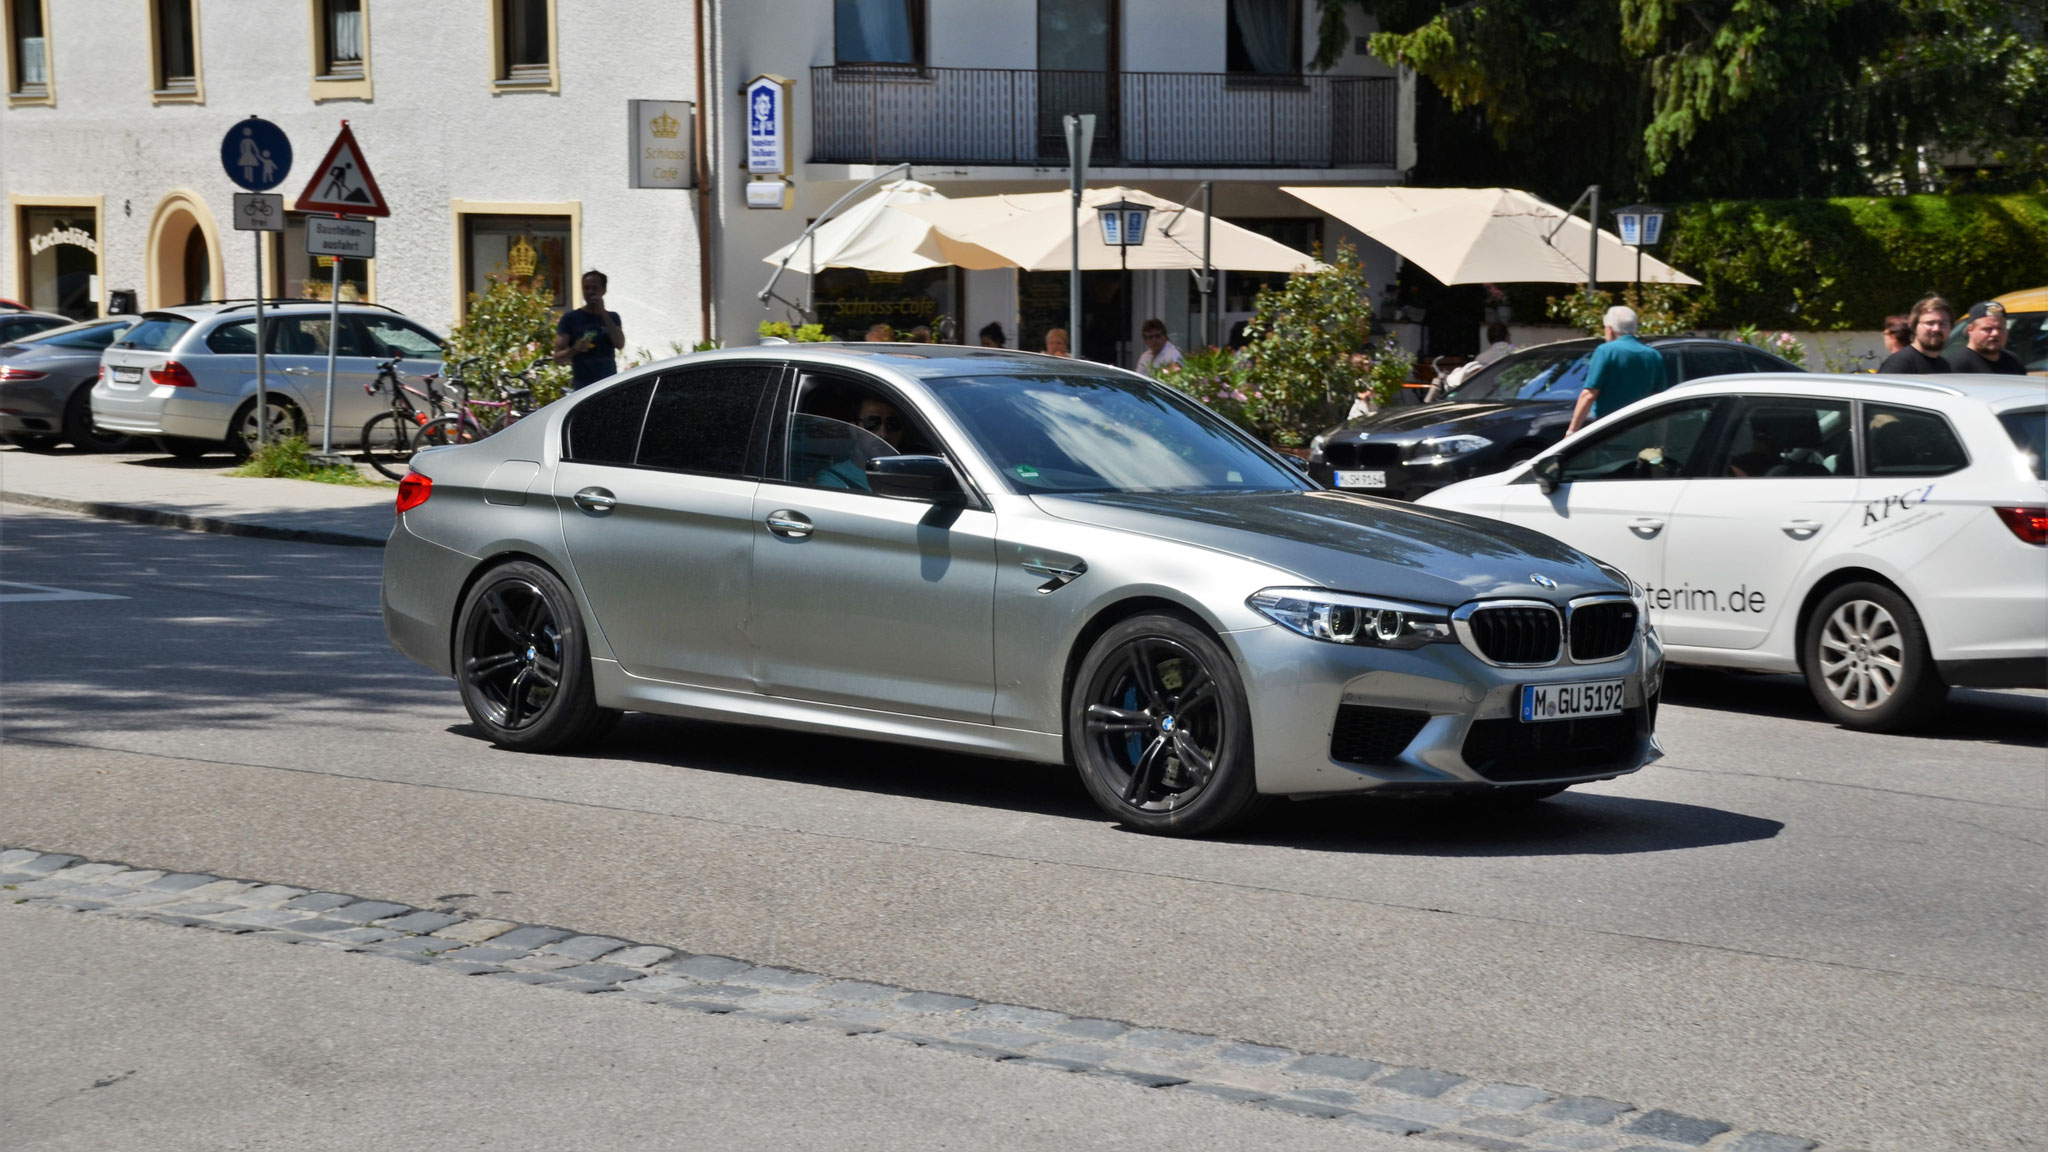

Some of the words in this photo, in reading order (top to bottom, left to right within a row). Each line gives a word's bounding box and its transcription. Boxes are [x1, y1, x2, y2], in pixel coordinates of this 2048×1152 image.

[645, 147, 686, 160] Schloss
[316, 223, 366, 237] Baustellen-
[322, 240, 359, 251] ausfahrt
[1534, 689, 1547, 716] M
